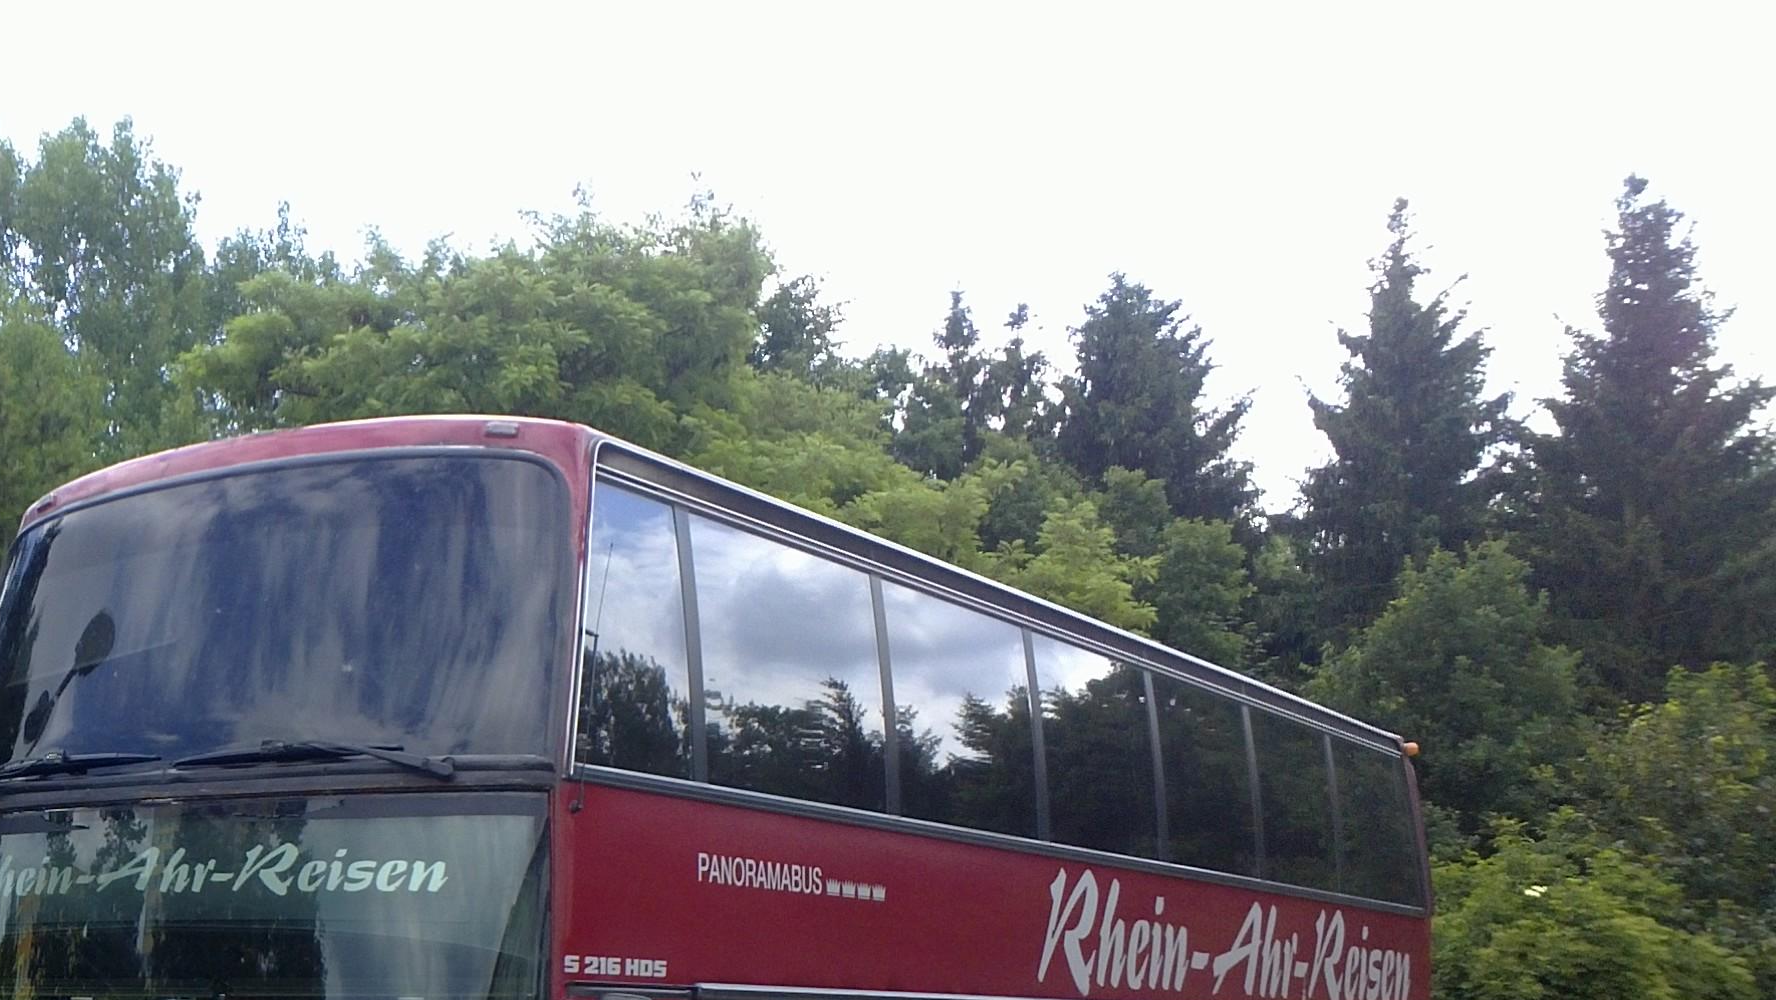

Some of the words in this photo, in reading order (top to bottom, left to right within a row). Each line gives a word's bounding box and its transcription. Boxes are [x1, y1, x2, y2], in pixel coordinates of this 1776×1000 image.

[698, 852, 823, 895] PANORAMABUS
[564, 955, 580, 973] S
[584, 956, 621, 975] 216
[625, 958, 667, 977] HDS
